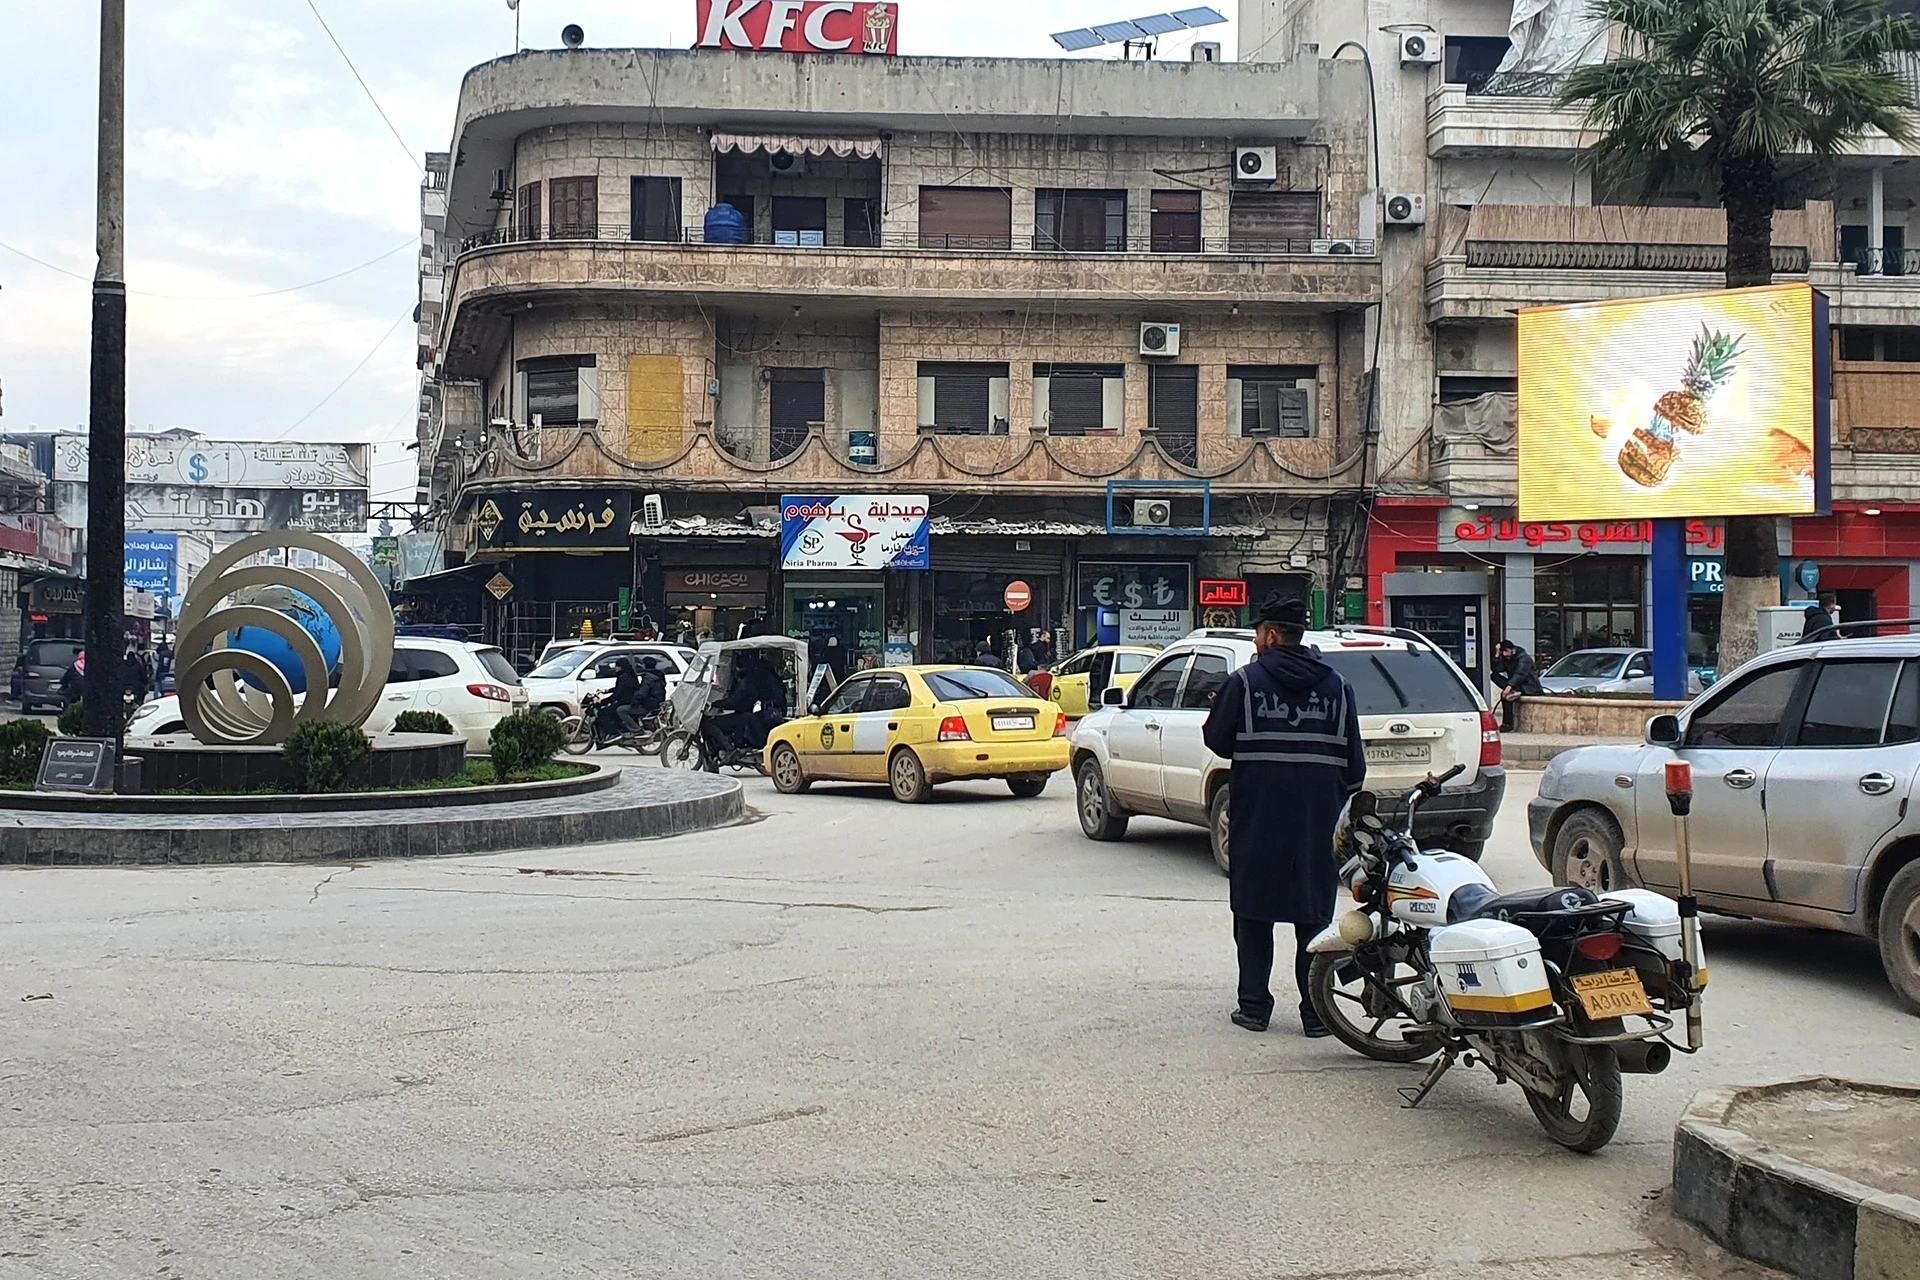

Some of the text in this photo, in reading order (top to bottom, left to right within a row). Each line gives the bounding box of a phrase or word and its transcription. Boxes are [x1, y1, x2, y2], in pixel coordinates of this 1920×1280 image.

[699, 0, 854, 50] KFC
[865, 42, 886, 51] KFC
[302, 490, 340, 512] نيو
[518, 499, 615, 536] فرنسية
[784, 501, 926, 522] صيدلية برهوم
[802, 534, 820, 549] SP
[891, 530, 914, 541] معمل
[1685, 520, 1722, 548] رك
[881, 542, 901, 554] فارما
[785, 558, 838, 567] Siria Pharma
[1691, 562, 1722, 581] PR
[1206, 586, 1238, 601] العالم
[1129, 611, 1180, 624] الليث
[1253, 690, 1337, 727] الشرطة
